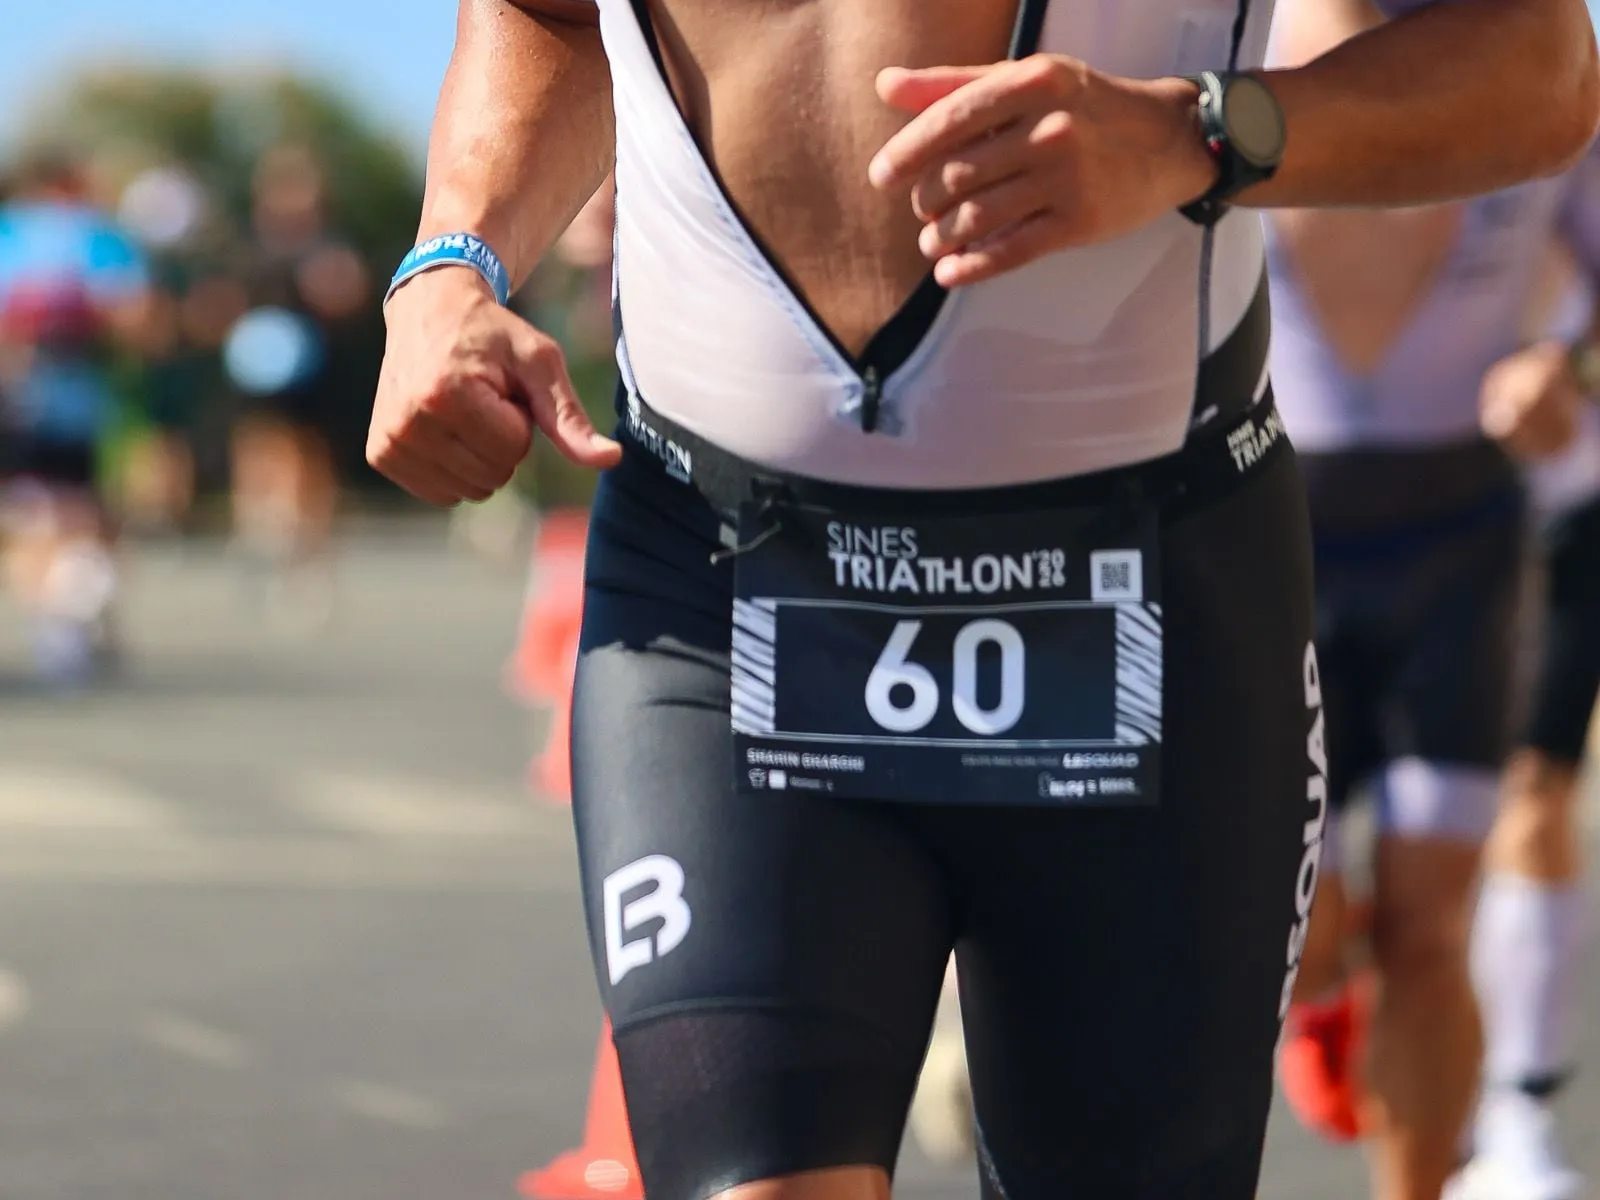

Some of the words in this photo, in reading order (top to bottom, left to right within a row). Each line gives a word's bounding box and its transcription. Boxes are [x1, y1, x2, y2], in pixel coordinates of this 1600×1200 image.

[827, 520, 919, 560] SINES
[828, 551, 1033, 594] TRIATHLON
[864, 617, 1026, 735] 60
